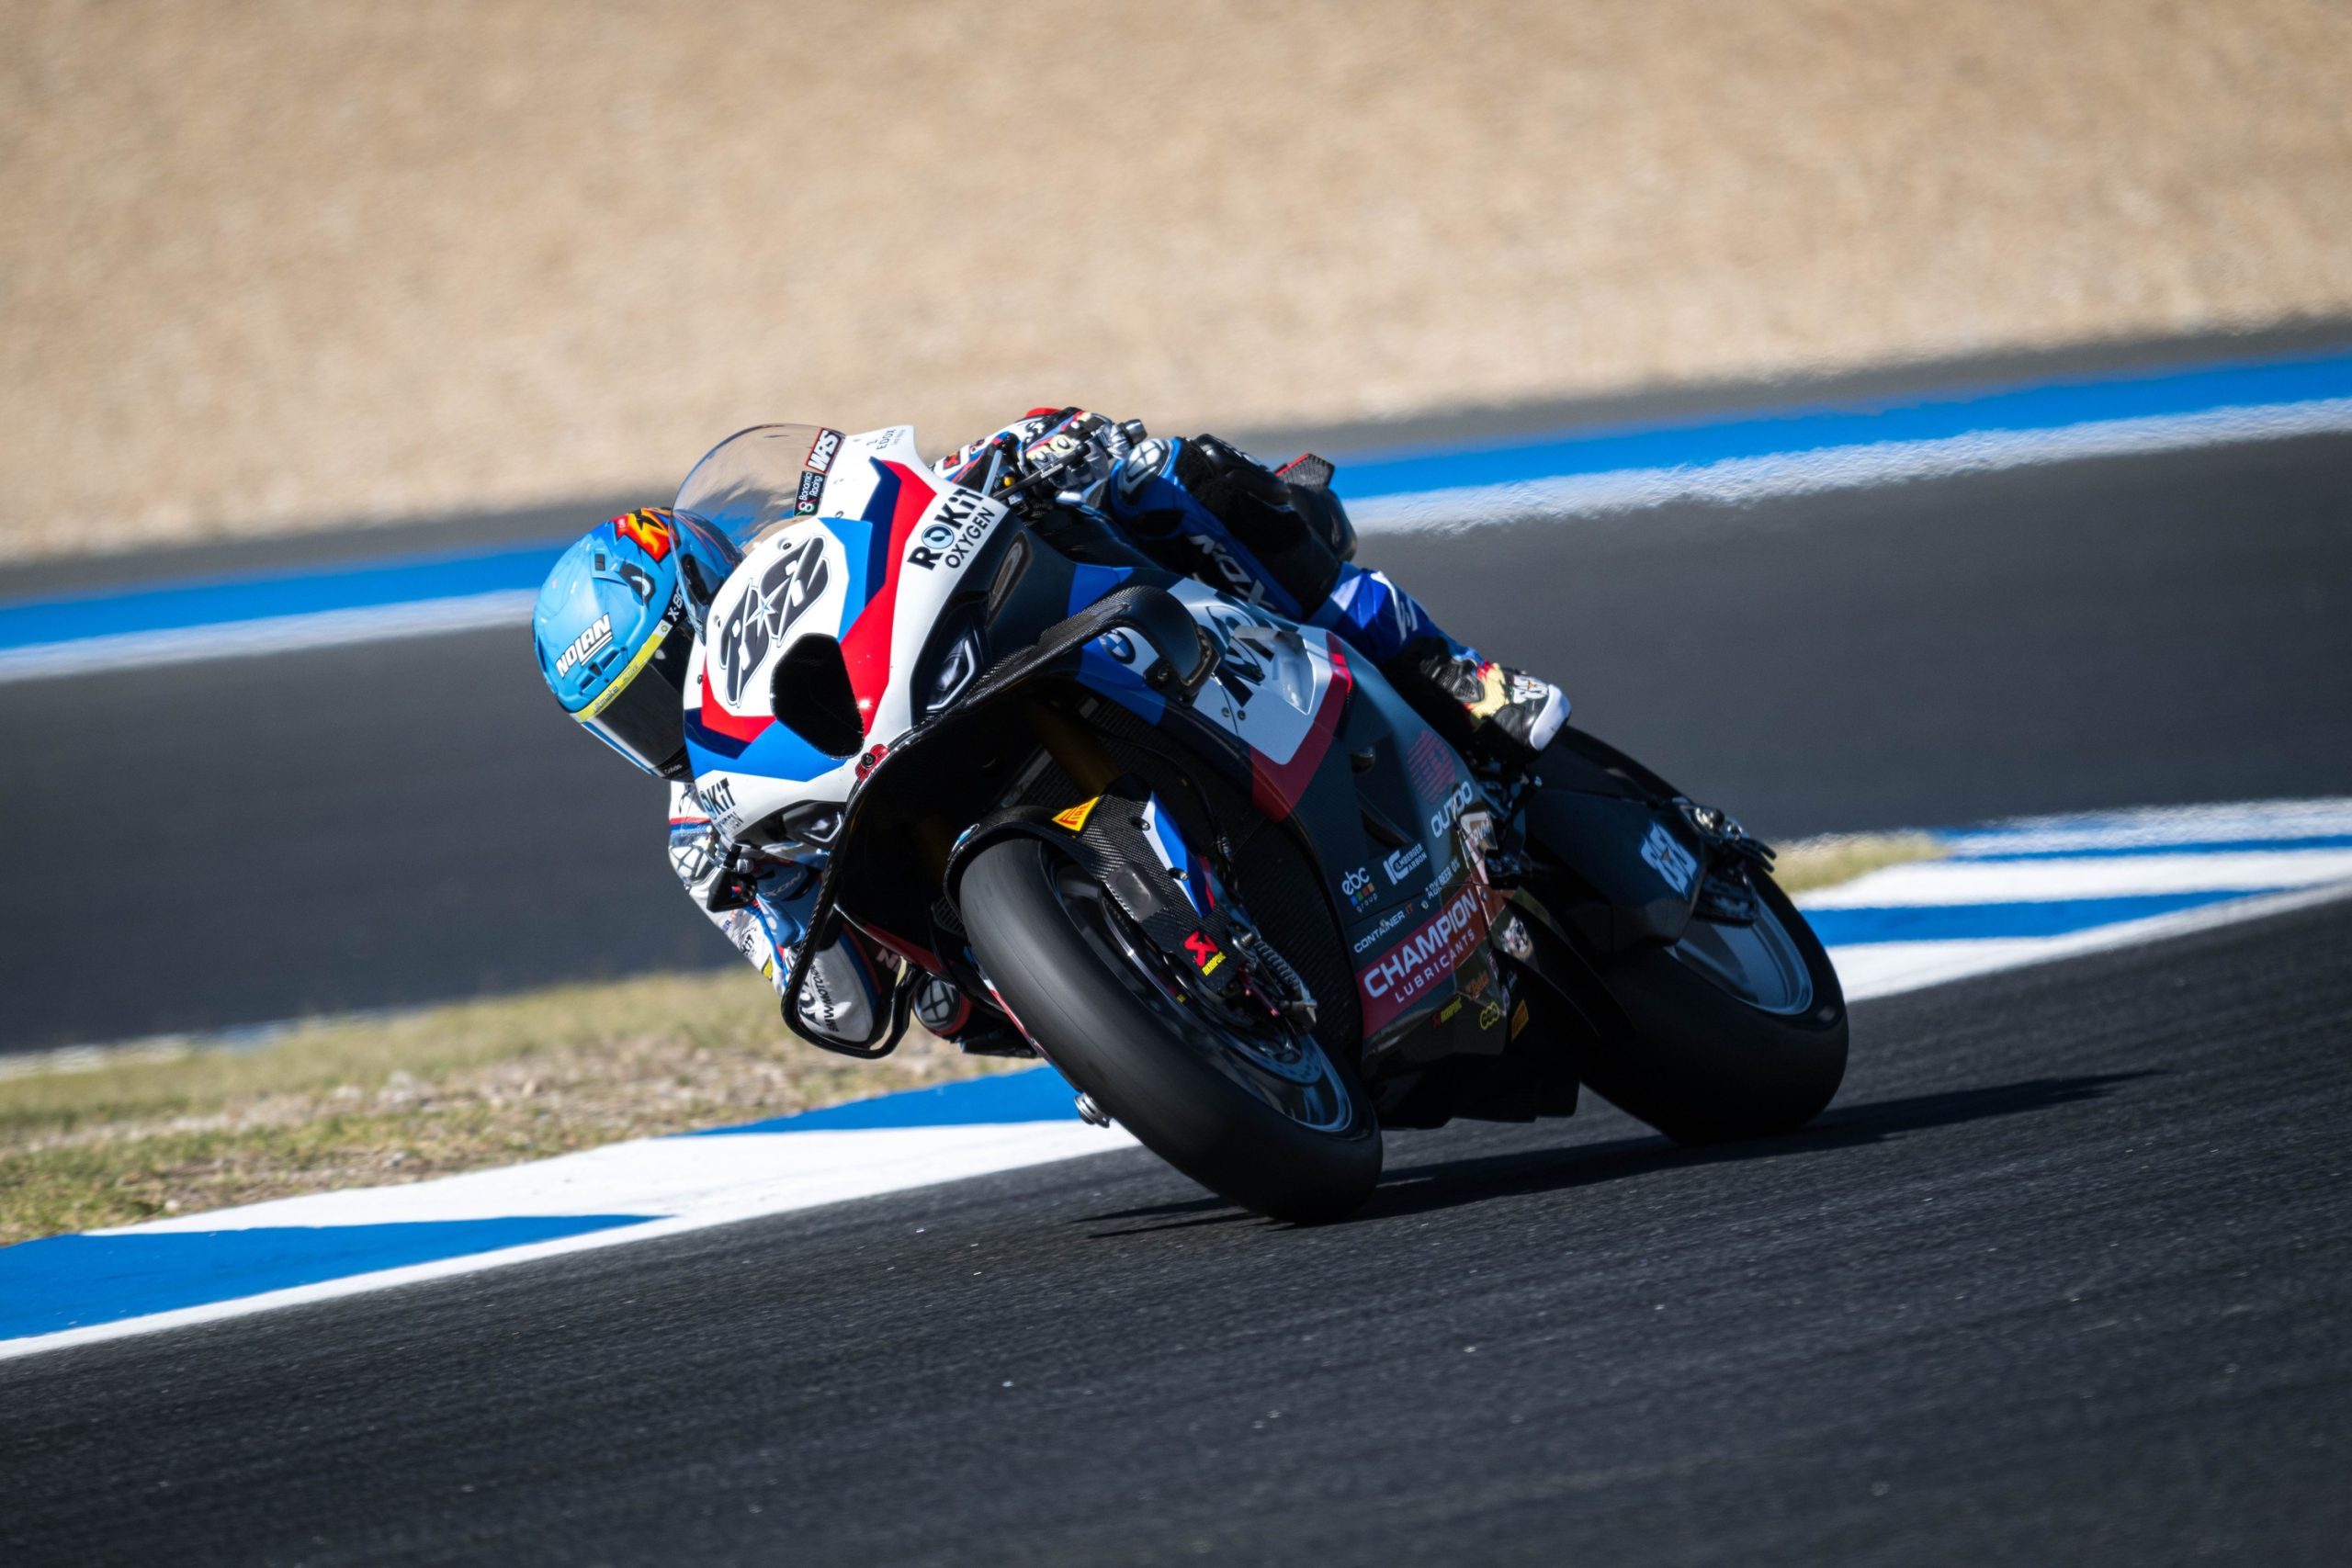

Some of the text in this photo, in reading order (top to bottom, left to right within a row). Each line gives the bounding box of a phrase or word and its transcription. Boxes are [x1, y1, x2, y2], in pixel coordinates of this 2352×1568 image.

[808, 429, 841, 470] WRS
[809, 475, 823, 497] Racing
[944, 506, 995, 569] OXYGEN
[555, 613, 613, 679] NOLAN
[1341, 867, 1370, 895] ebc
[1356, 894, 1378, 913] group
[1363, 887, 1478, 998] CHAMPION
[1395, 929, 1475, 1003] LUBRICANTS
